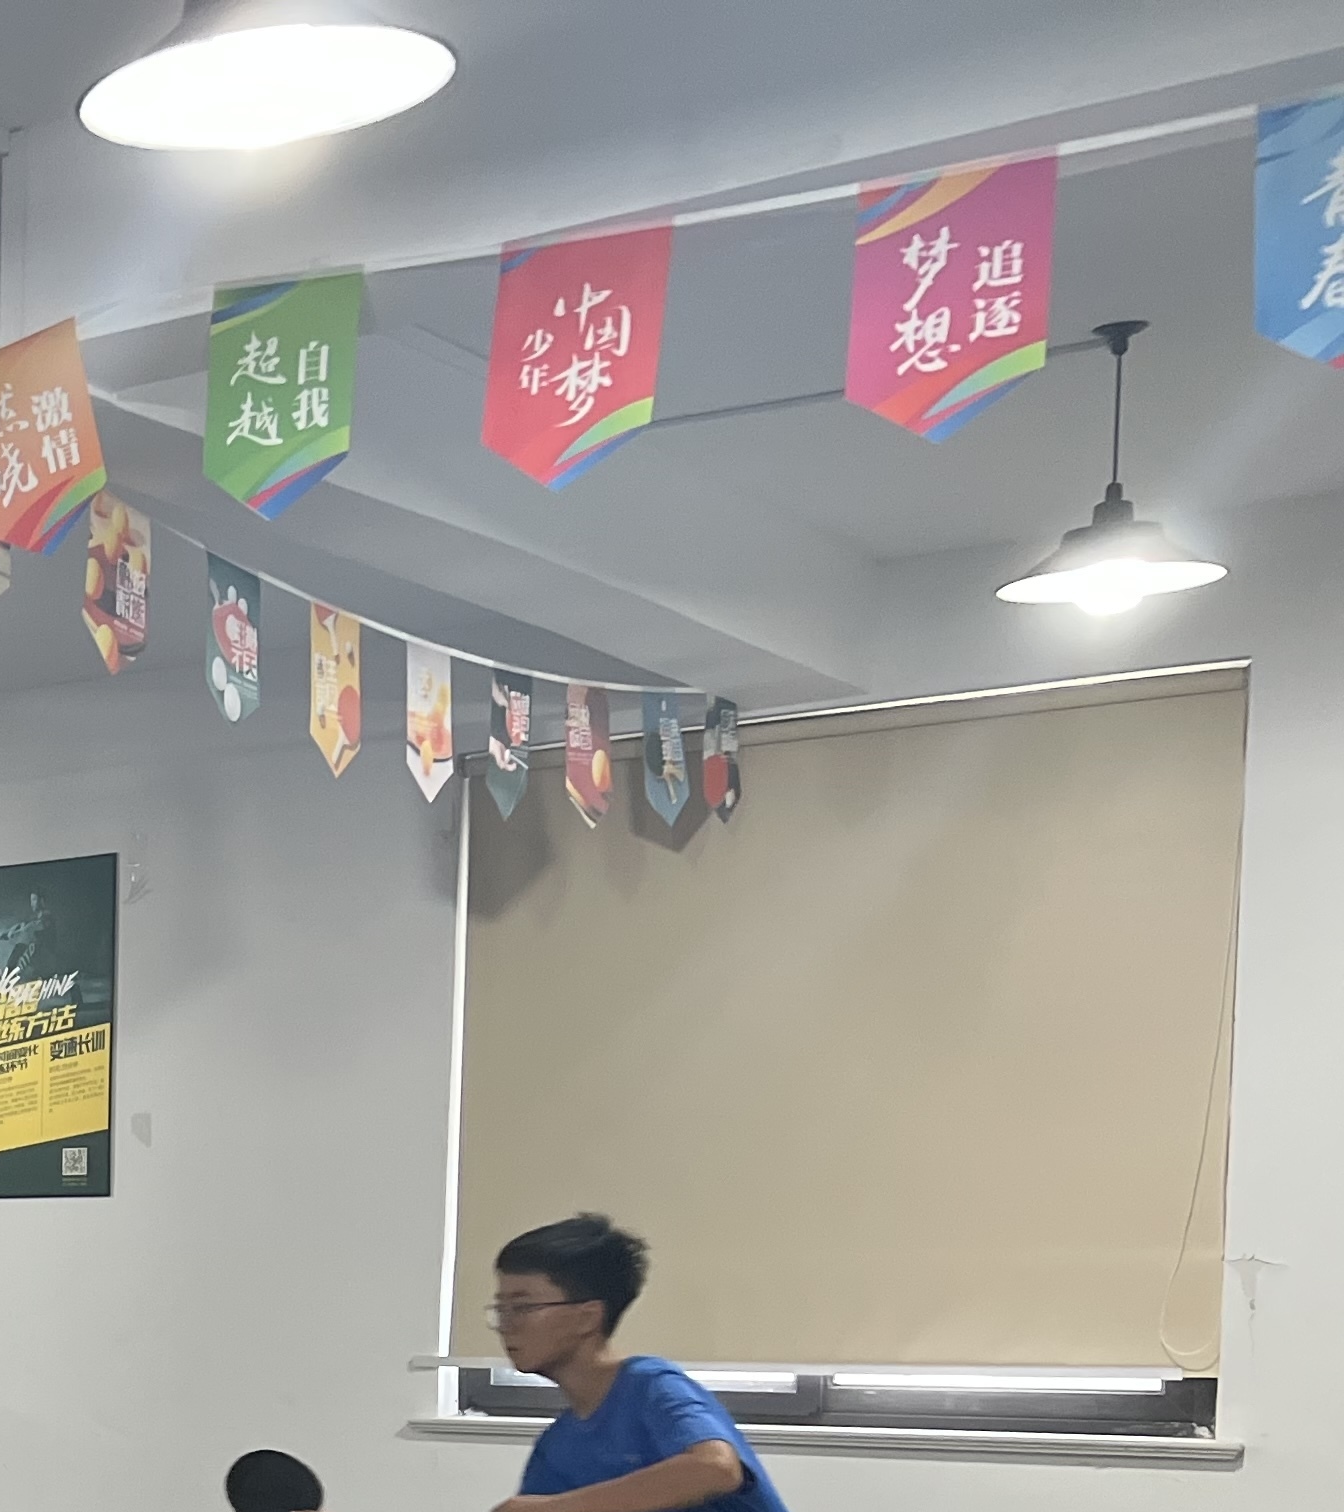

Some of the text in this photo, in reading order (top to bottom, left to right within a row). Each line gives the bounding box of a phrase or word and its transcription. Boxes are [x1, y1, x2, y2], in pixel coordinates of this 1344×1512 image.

[894, 226, 962, 378] 梦想
[969, 238, 1026, 344] 追逐
[226, 331, 287, 448] 超越
[291, 341, 331, 431] 自我
[519, 328, 554, 396] 少年
[548, 282, 632, 430] 中国梦
[30, 386, 81, 475] 激情
